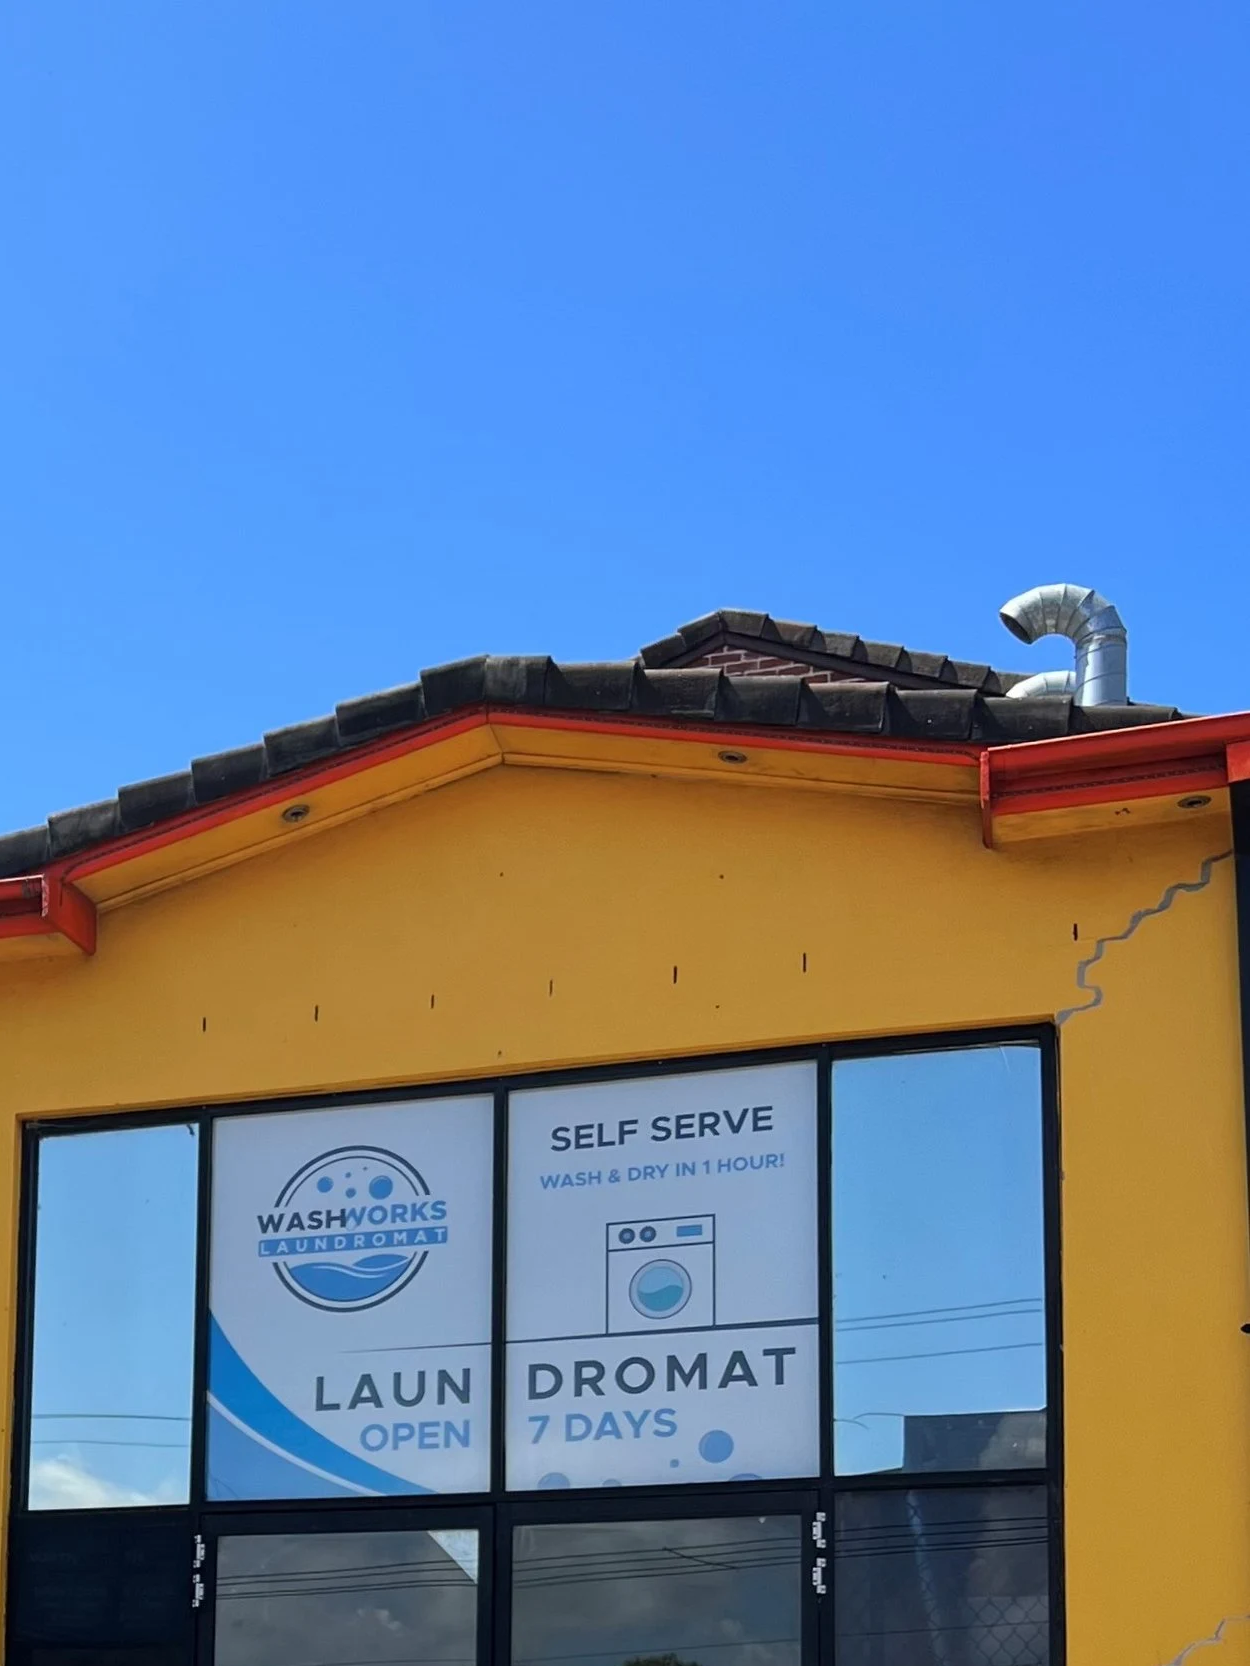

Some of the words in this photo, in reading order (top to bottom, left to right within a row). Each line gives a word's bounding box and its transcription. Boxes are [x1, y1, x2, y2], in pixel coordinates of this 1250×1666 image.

[550, 1118, 639, 1152] SELF
[650, 1105, 774, 1142] SERVE
[540, 1170, 602, 1190] WASH
[607, 1168, 621, 1184] &
[627, 1163, 670, 1182] DRY
[675, 1161, 696, 1177] IN
[702, 1159, 710, 1175] 1
[716, 1152, 785, 1174] HOUR!
[260, 1227, 446, 1255] LAUNDROMAT
[315, 1367, 471, 1412] LAUN
[527, 1347, 796, 1401] DROMAT
[359, 1419, 471, 1452] OPEN
[527, 1414, 550, 1445] 7
[564, 1407, 678, 1443] DAYS
